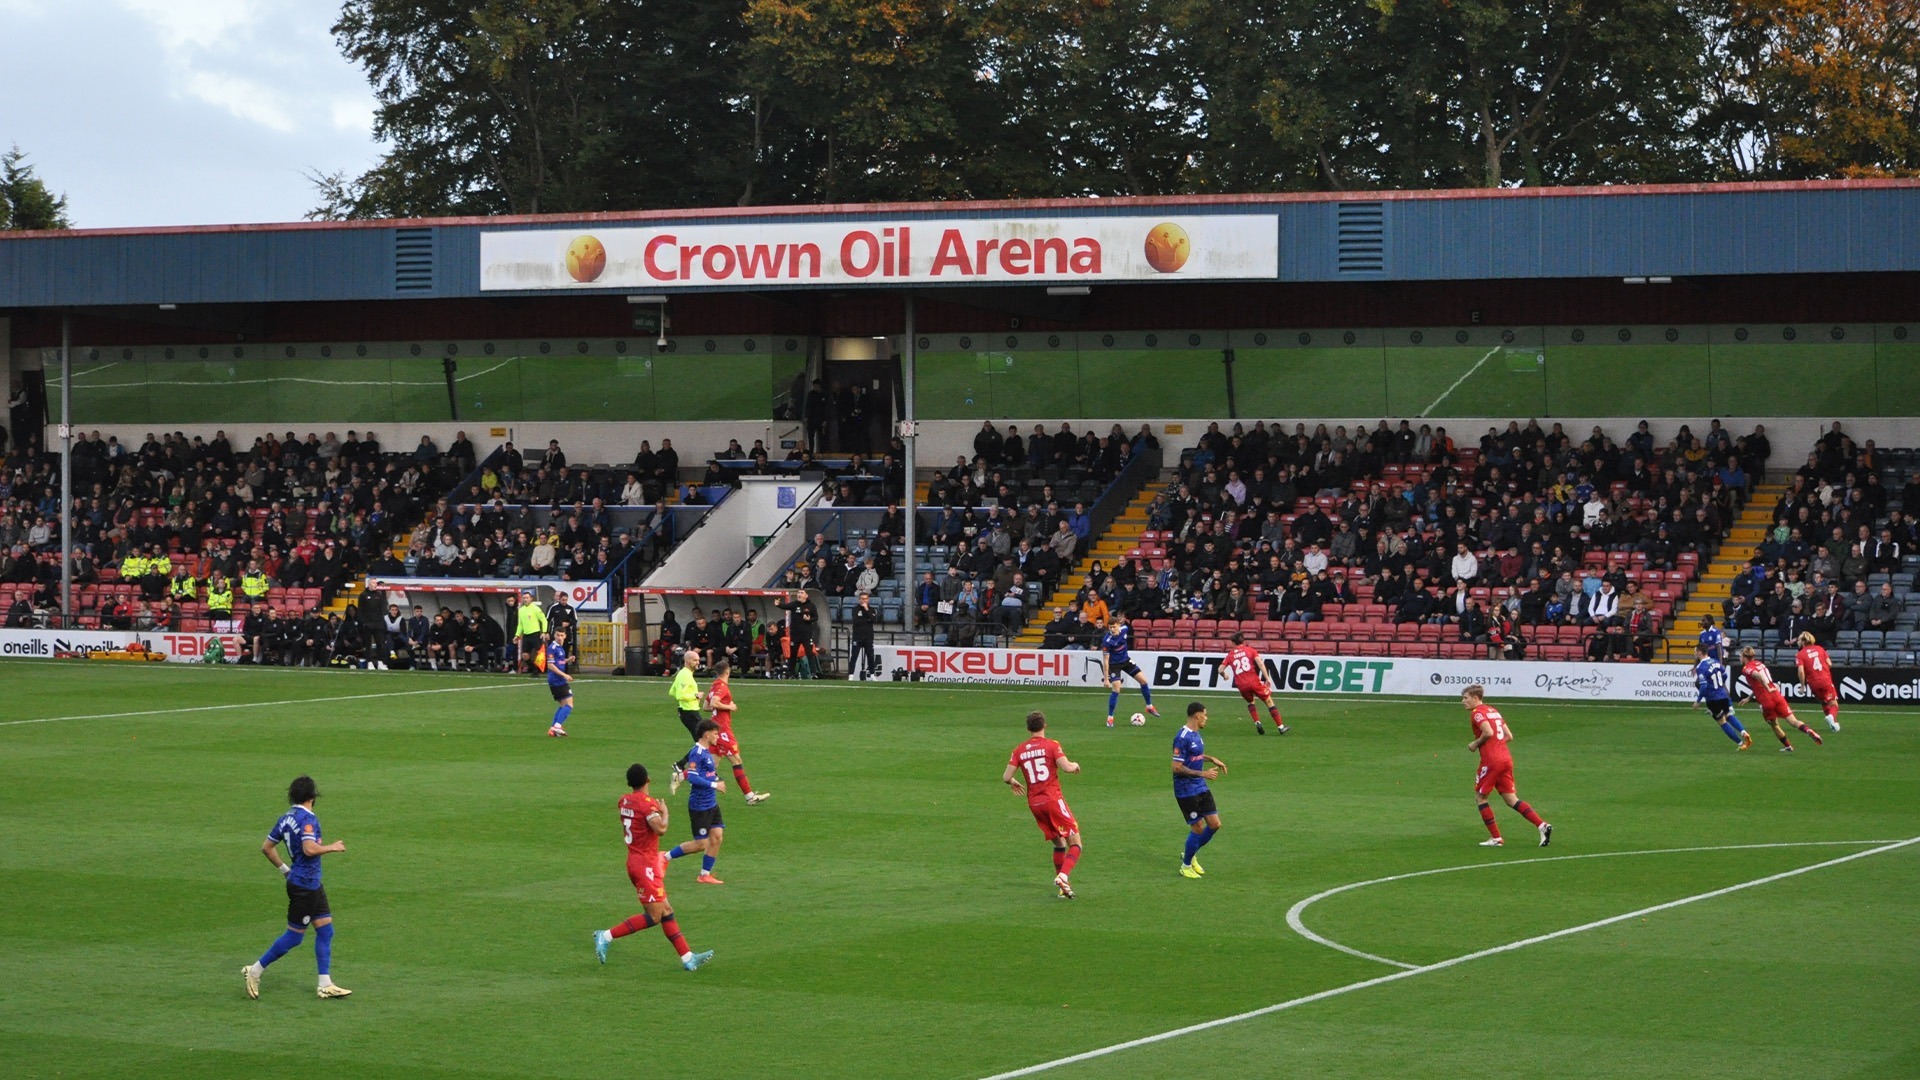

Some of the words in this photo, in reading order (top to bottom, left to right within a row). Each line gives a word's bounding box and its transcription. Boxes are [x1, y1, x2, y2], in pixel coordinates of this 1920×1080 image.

[643, 234, 821, 281] Crown
[839, 226, 910, 278] Oil
[929, 228, 1102, 276] Arena
[572, 586, 598, 602] Oil
[1232, 656, 1251, 675] 28
[1812, 656, 1823, 671] 4
[1153, 656, 1394, 692] BETNG.BET
[1444, 675, 1473, 685] 03300
[1475, 676, 1491, 685] 531
[1494, 676, 1512, 685] 744
[1535, 673, 1597, 692] Options
[1641, 679, 1668, 687] COACH
[1634, 689, 1650, 697] FOR
[1651, 689, 1692, 698] ROCHDALE
[1693, 690, 1699, 698] A
[1023, 757, 1050, 784] 15
[622, 818, 634, 845] 3
